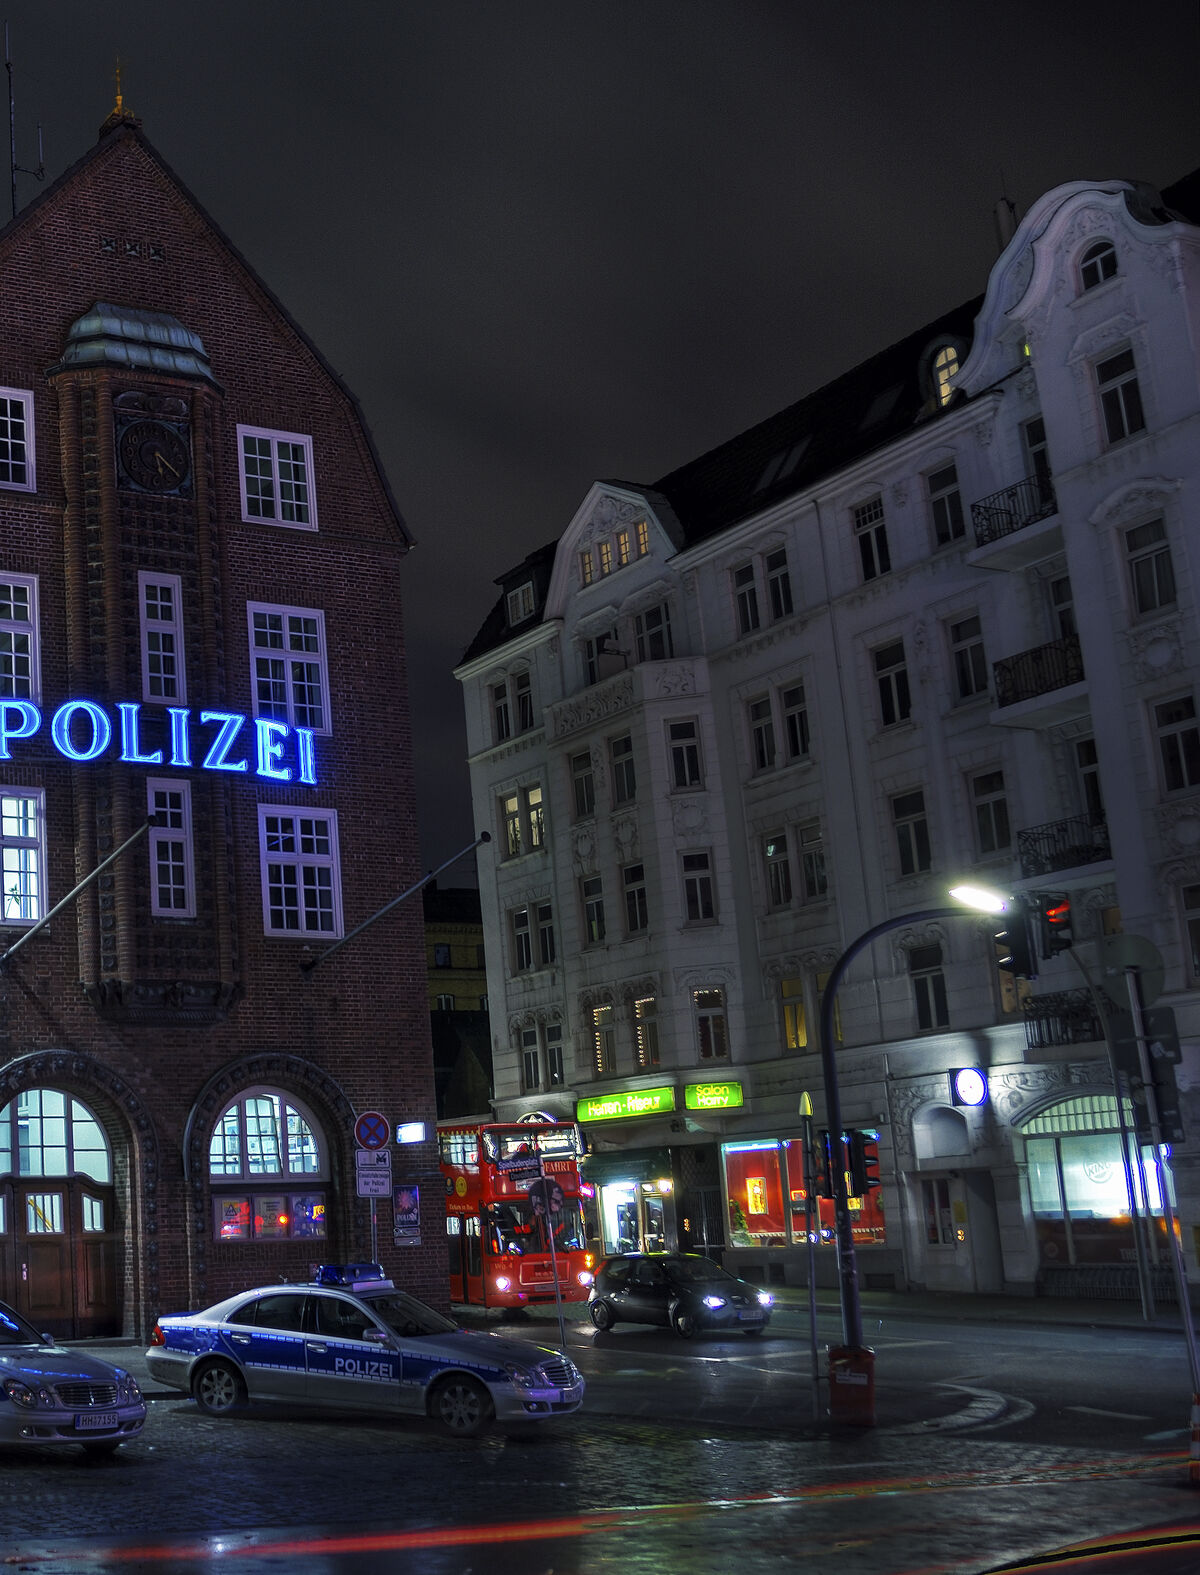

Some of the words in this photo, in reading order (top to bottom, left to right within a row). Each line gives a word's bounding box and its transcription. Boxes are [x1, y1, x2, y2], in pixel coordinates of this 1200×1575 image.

[695, 1084, 730, 1096] Salon
[697, 1095, 729, 1107] Harry
[335, 1357, 393, 1378] POLIZEI
